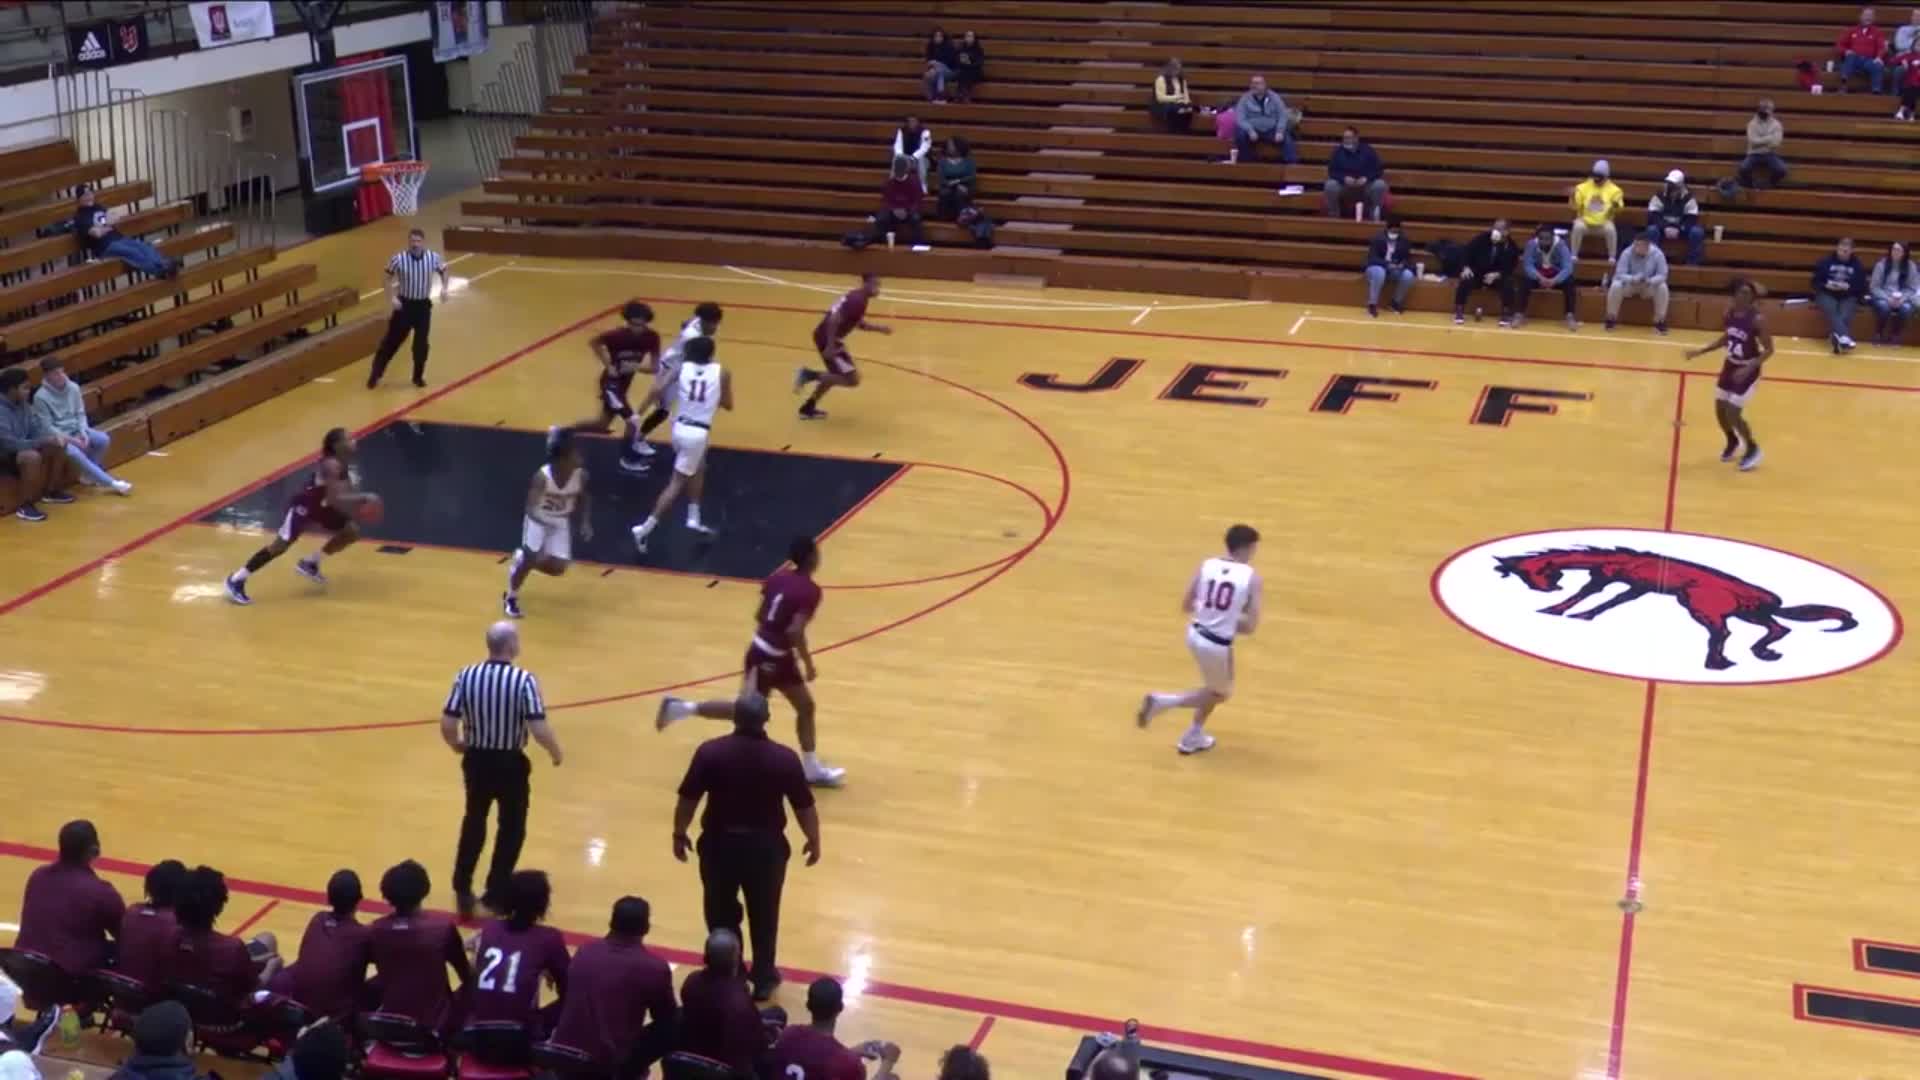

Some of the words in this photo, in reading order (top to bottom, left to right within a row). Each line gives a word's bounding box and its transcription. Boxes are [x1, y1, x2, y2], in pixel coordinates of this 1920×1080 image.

[689, 380, 706, 403] 11
[1016, 356, 1594, 428] JEFF
[767, 592, 784, 621] 1
[1204, 579, 1235, 611] 10
[478, 946, 521, 993] 21
